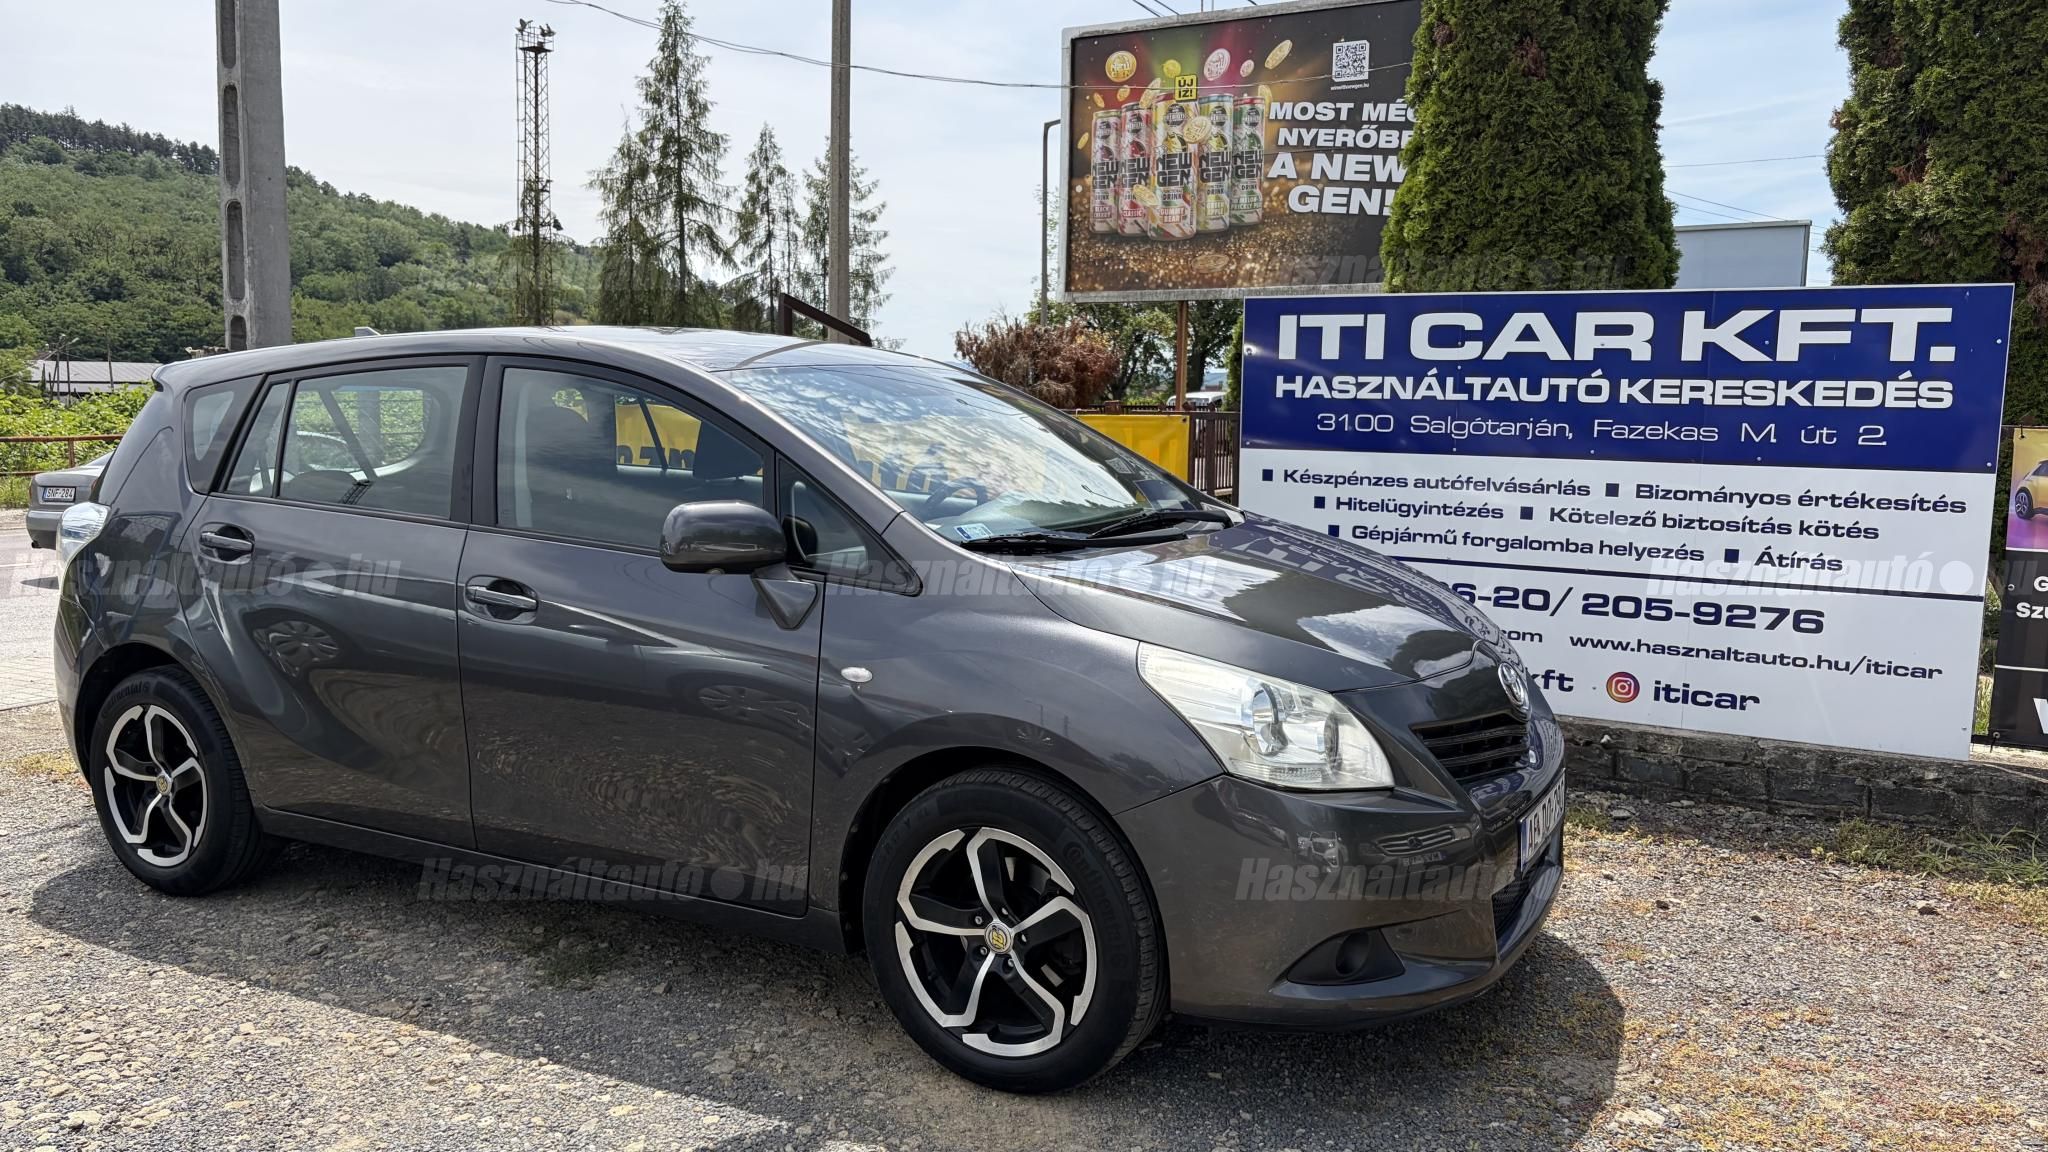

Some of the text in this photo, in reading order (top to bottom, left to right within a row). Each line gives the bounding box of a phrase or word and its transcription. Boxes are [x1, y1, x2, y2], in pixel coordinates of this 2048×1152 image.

[1269, 101, 1355, 121] MOST
[1156, 152, 1192, 171] NEW
[1199, 151, 1231, 168] NEW
[1200, 166, 1231, 183] GEN
[1235, 163, 1263, 179] GEN
[1266, 151, 1408, 183] A NEW
[1156, 170, 1191, 187] GEN
[1288, 184, 1397, 217] GEN!
[1279, 307, 1956, 362] ITI CAR KFT.
[1275, 367, 1954, 409] HASZNÁLTAUTÓ KERESKEDÉS
[1316, 412, 1394, 432] 3100
[1410, 414, 1573, 439] Salgótarján,
[1593, 419, 1720, 442] Fazekas
[1800, 425, 1837, 445] út
[1282, 468, 1968, 514] Készpénzes autófelvásárlás Bizományos értékesítés
[1335, 496, 1880, 540] Hitelügyintézés Kötelező biztosítás kötés
[1351, 525, 1843, 571] Gépjármű forgalomba helyezés Átírás
[1446, 582, 1825, 634] 6-20/205-9276
[1569, 636, 1943, 680] www.hasznaltauto.hu/iticar
[1653, 680, 1761, 711] iticar
